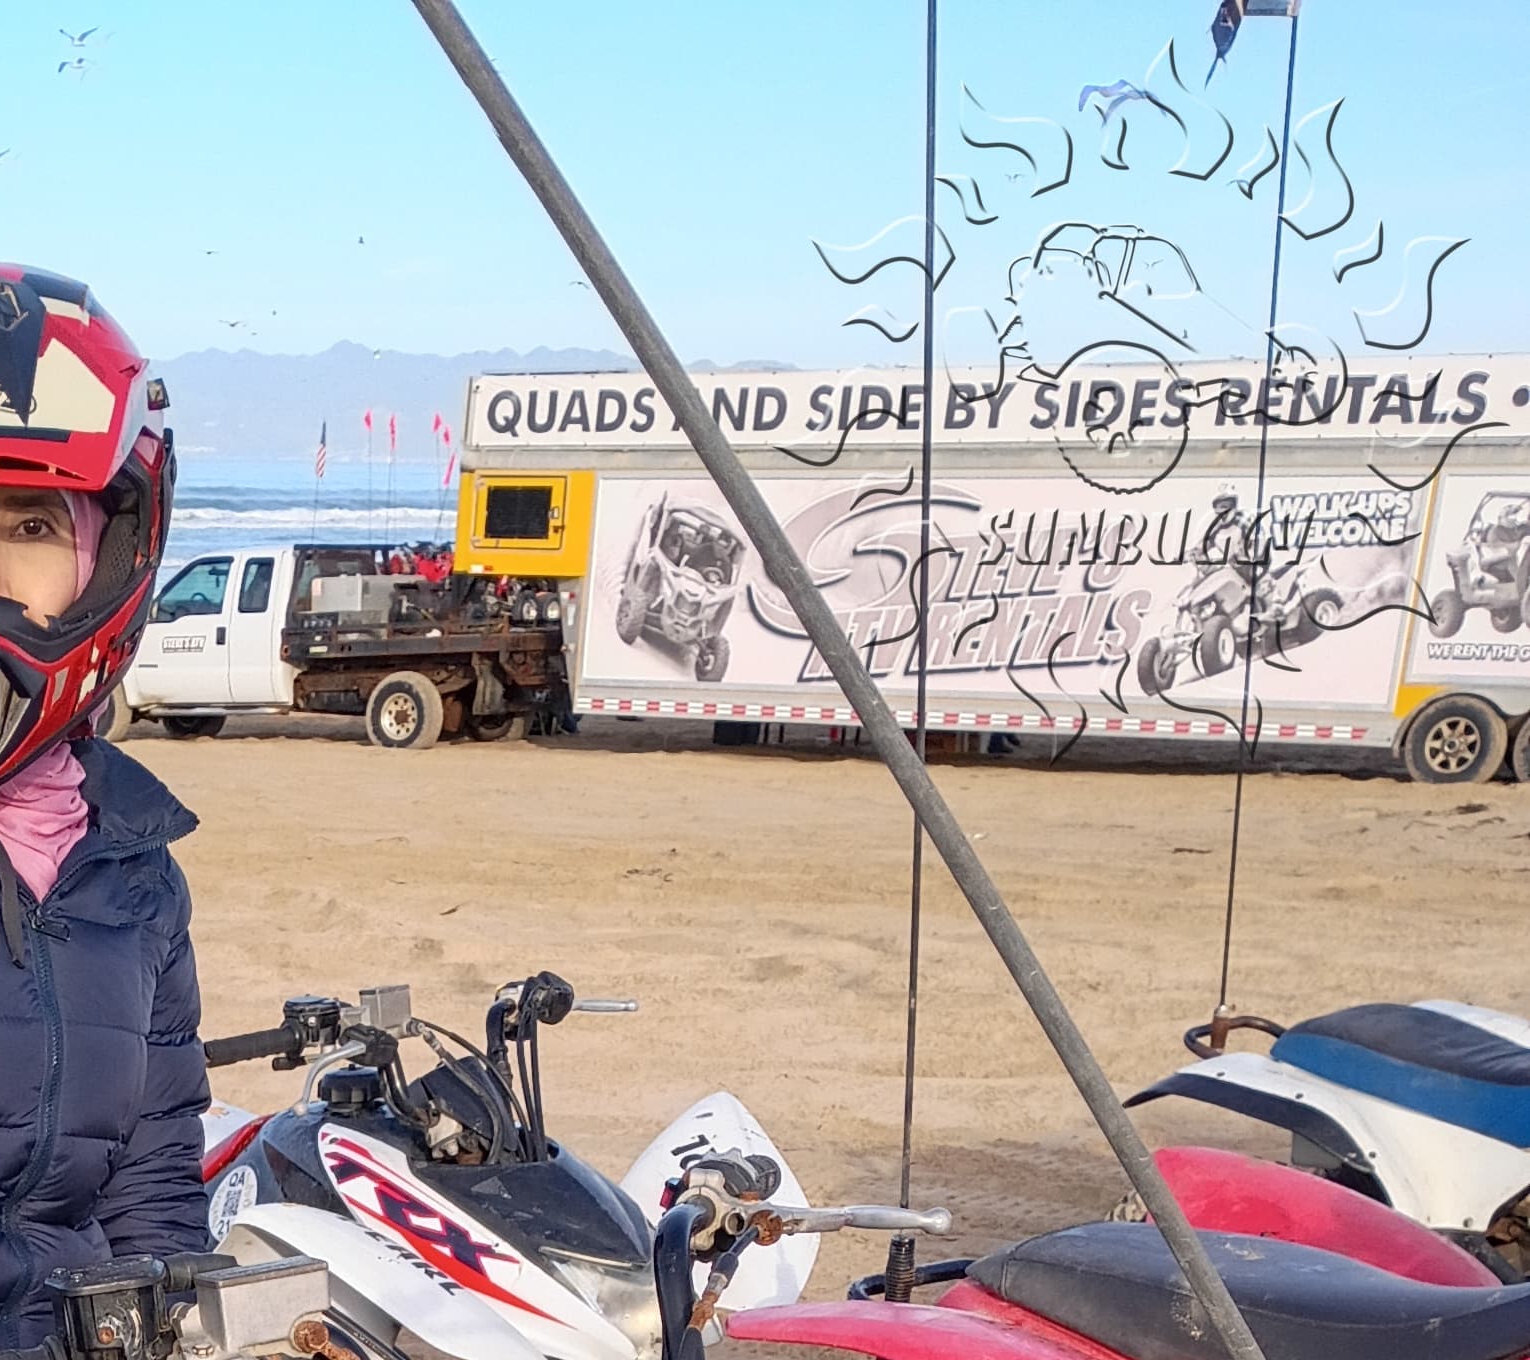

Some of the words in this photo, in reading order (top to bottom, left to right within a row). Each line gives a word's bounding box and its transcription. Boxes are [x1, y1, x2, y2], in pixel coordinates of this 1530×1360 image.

[486, 388, 657, 438] QUADS
[670, 387, 789, 432] ND
[805, 384, 926, 431] SIDE
[944, 382, 1018, 430] BY
[1030, 377, 1196, 428] SIDES
[1213, 371, 1491, 427] RENTALS
[1269, 489, 1413, 523] WALK-UPS
[1270, 516, 1408, 548] WELCOME
[904, 588, 1154, 676] RENTALS
[1427, 643, 1451, 660] WE
[1451, 643, 1490, 660] RENT
[1490, 643, 1519, 661] THE
